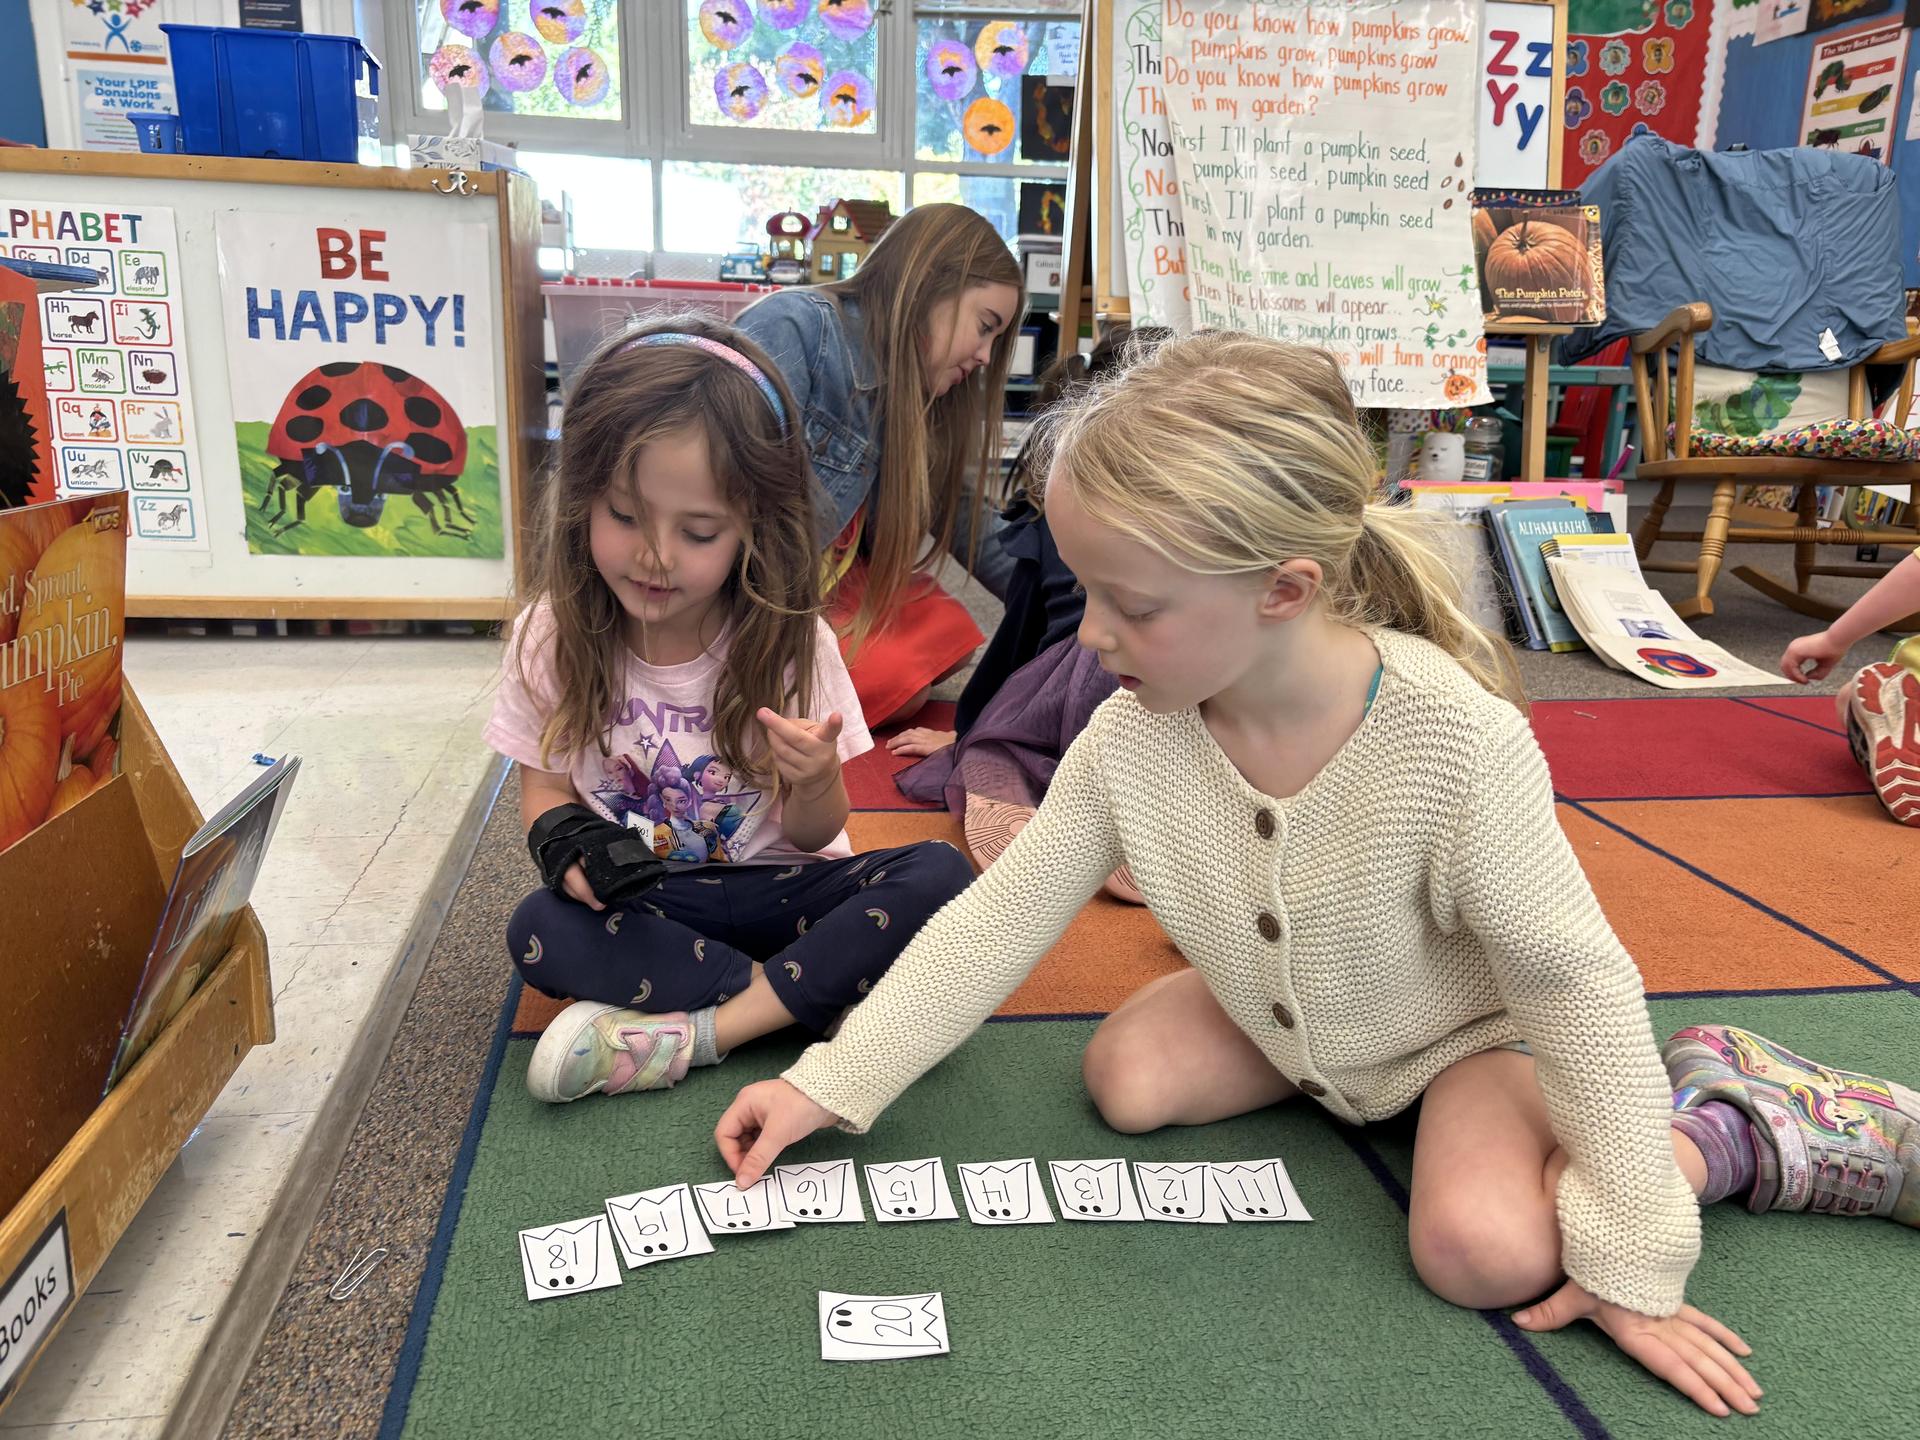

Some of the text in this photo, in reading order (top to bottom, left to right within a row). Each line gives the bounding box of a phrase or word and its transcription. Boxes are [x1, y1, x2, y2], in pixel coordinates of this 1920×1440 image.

[1167, 0, 1194, 28] Do
[1204, 11, 1238, 38] you
[1253, 4, 1296, 34] know
[1306, 7, 1339, 36] how
[1352, 11, 1420, 45] pumpkins
[1191, 36, 1268, 65] pumpkins
[1328, 43, 1396, 71] pumpkins
[1401, 53, 1438, 74] grow
[1823, 48, 1836, 57] The
[1837, 45, 1852, 53] Very
[1853, 40, 1869, 49] Best
[96, 77, 159, 90] Your LPIE
[1165, 56, 1448, 103] Do you know how pumpkins grow
[95, 87, 161, 100] Donations
[102, 97, 155, 110] at Work
[1191, 92, 1319, 122] in my garden?
[1171, 121, 1207, 152] First
[1221, 125, 1246, 153] I'll
[1253, 127, 1291, 159] plant
[1304, 141, 1313, 155] a
[1321, 130, 1380, 164] pumpkin
[1193, 157, 1257, 186] pumpkin
[1328, 163, 1387, 192] pumpkin
[1393, 170, 1429, 190] seed
[1182, 181, 1433, 232] First I'll plant a pumpkin seed
[1204, 219, 1217, 241] in
[1222, 230, 1242, 251] my
[71, 252, 90, 264] Dd
[124, 254, 141, 266] Ee
[316, 228, 389, 281] BE
[1154, 245, 1185, 276] But
[1188, 243, 1224, 278] Then
[1229, 258, 1252, 284] the
[1263, 265, 1289, 286] vine
[1296, 262, 1319, 288] and
[1327, 262, 1374, 290] leaves
[1382, 265, 1404, 292] will
[1193, 272, 1221, 301] Then
[1226, 282, 1245, 308] the
[1249, 285, 1307, 312] blossoms
[1315, 292, 1335, 313] will
[1495, 287, 1588, 303] The Pumpkin Patch
[50, 301, 69, 313] Hh
[115, 304, 129, 316] Ii
[246, 287, 465, 347] HAPPY!
[1256, 313, 1290, 338] little
[1298, 317, 1350, 345] pumpkin
[82, 353, 109, 365] Mm
[134, 354, 153, 367] Nn
[1360, 344, 1384, 366] will
[1394, 344, 1425, 366] turn
[1432, 354, 1488, 376] orange
[62, 402, 84, 418] Qq
[126, 404, 144, 415] Rr
[67, 450, 86, 462] Uu
[132, 453, 150, 464] Vv
[139, 500, 157, 511] Zz
[0, 574, 20, 618] d,
[57, 669, 84, 707] Pie
[796, 1179, 827, 1203] 16
[888, 1179, 917, 1202] 15
[982, 1179, 1011, 1204] 14
[1074, 1177, 1104, 1201] 13
[1157, 1178, 1188, 1201] 12
[1237, 1179, 1267, 1202] 11
[726, 1195, 750, 1215] 17
[634, 1210, 669, 1236] 19
[548, 1240, 578, 1269] 18
[871, 1304, 912, 1337] 20
